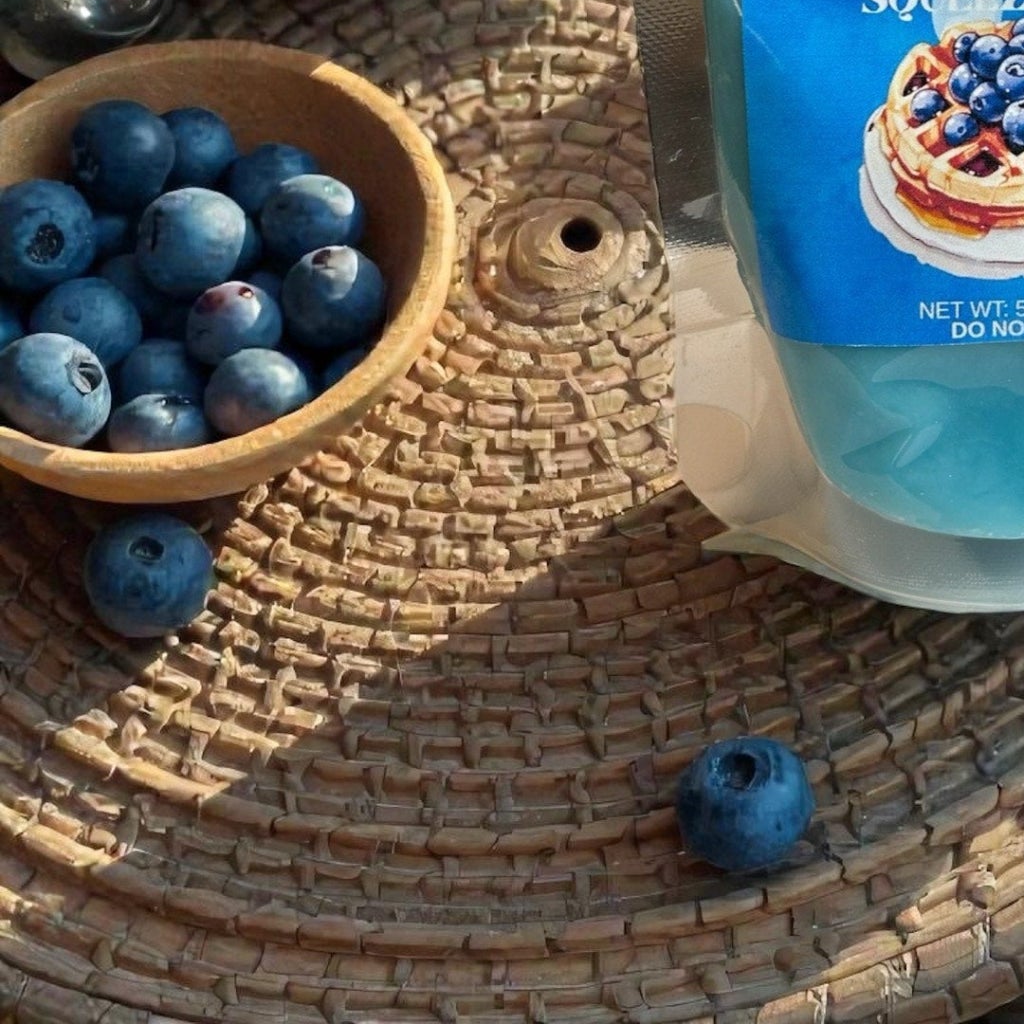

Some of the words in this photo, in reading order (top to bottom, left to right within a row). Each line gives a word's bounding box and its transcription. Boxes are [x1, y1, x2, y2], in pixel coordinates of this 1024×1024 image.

[919, 301, 965, 320] NET
[970, 300, 1009, 318] WT:
[951, 321, 986, 339] DO
